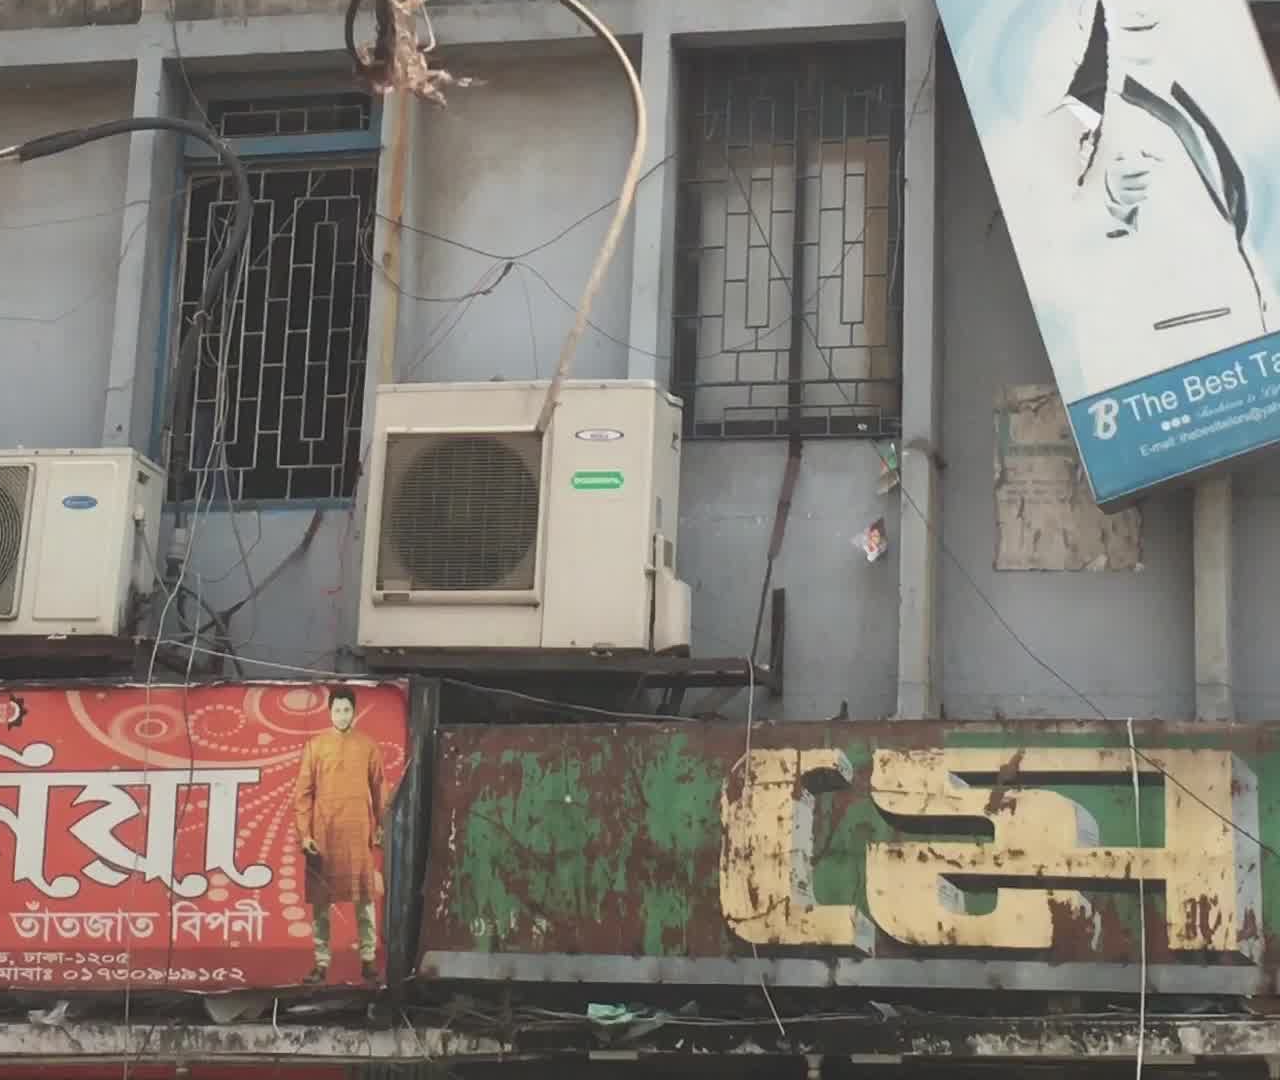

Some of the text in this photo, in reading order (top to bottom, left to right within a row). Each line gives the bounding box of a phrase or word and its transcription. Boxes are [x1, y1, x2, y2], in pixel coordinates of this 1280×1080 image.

[1122, 387, 1178, 422] The
[1183, 361, 1249, 404] Best
[9, 901, 160, 942] তাঁতজাত
